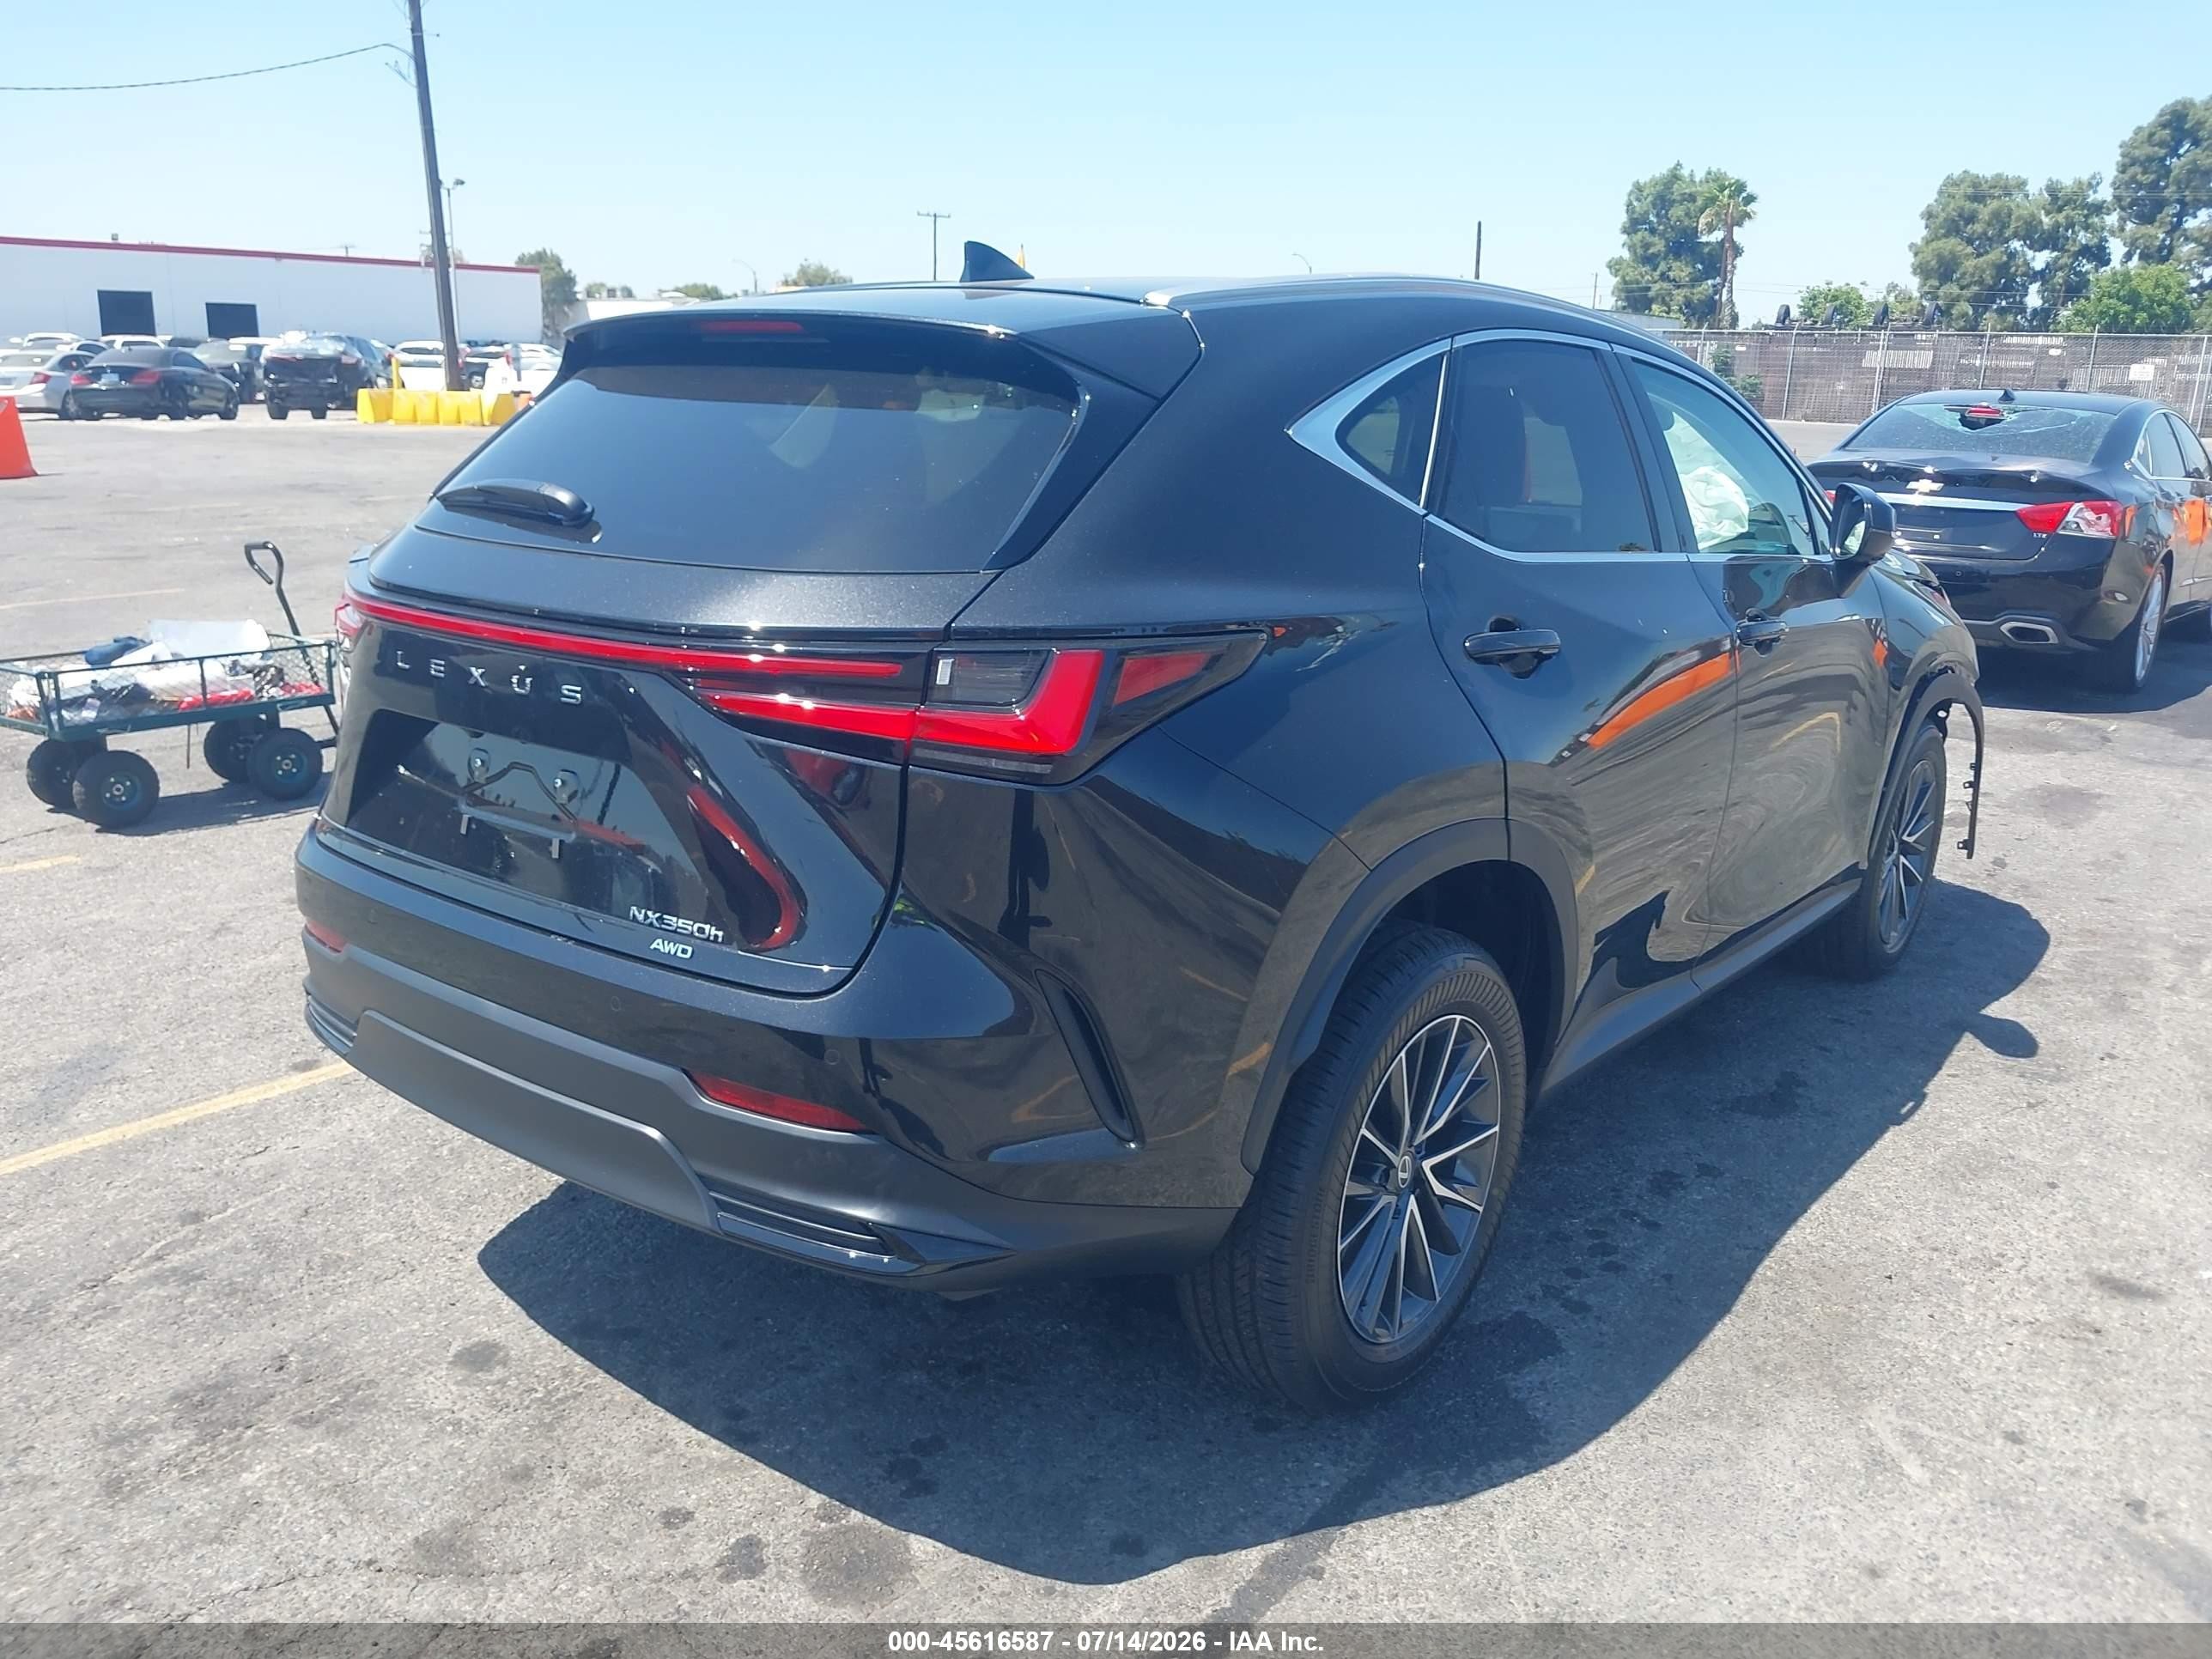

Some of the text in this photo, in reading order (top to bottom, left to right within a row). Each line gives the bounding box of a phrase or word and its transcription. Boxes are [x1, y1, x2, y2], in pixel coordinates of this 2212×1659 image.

[396, 650, 582, 705] LEXUS
[629, 906, 725, 943] NX350h
[649, 938, 695, 959] AWD
